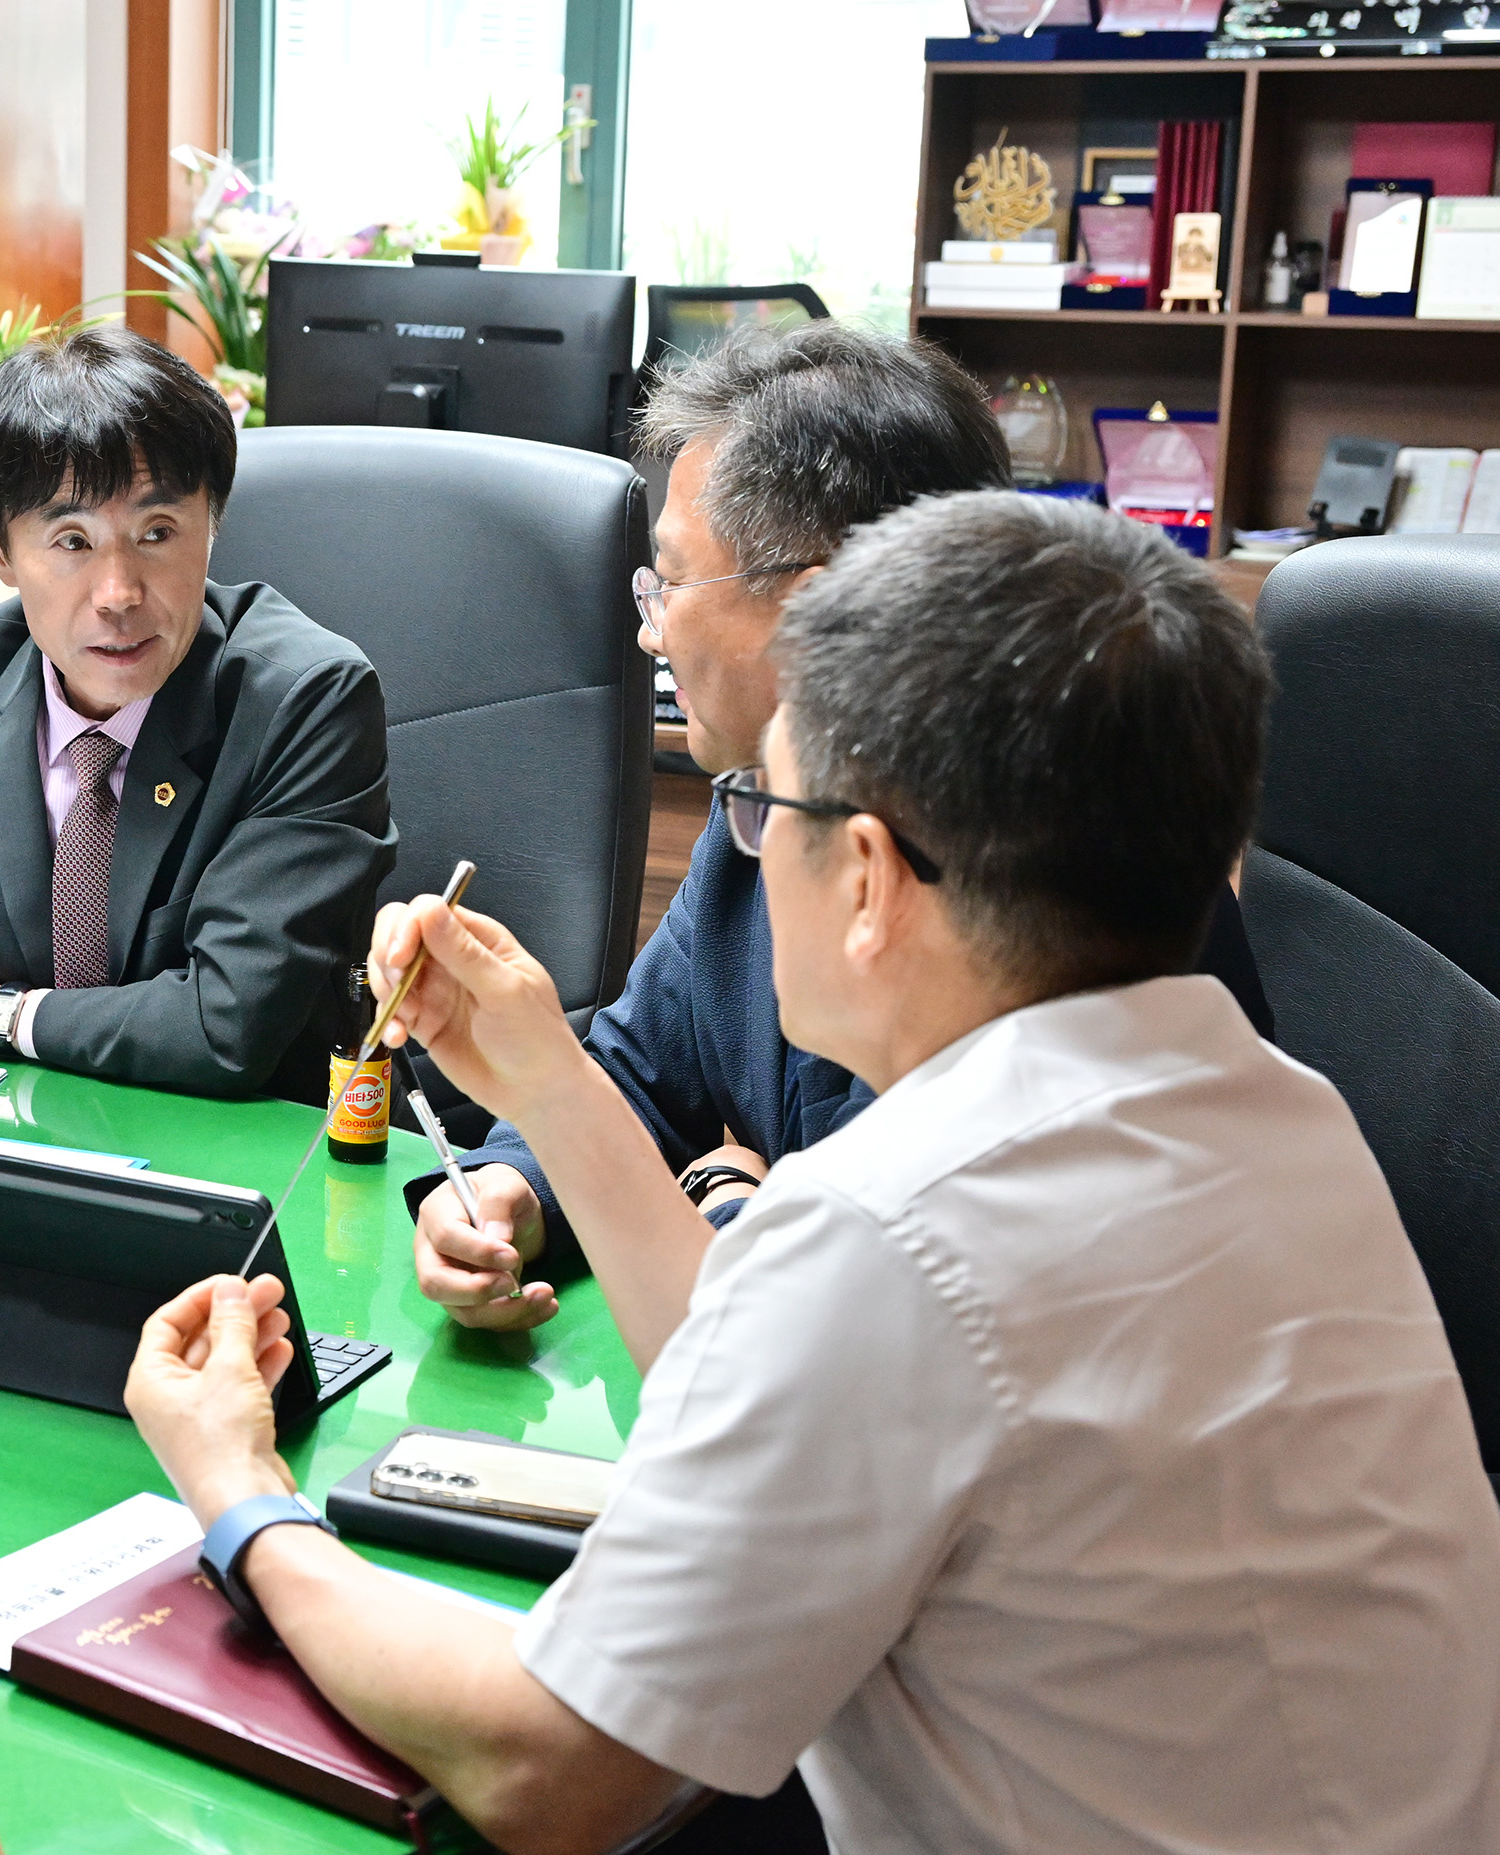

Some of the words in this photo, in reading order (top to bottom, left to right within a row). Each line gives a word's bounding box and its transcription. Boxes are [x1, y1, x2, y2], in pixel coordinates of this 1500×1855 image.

[395, 323, 466, 339] TREEM
[345, 1088, 384, 1102] 비타500
[340, 1119, 366, 1128] GOOD
